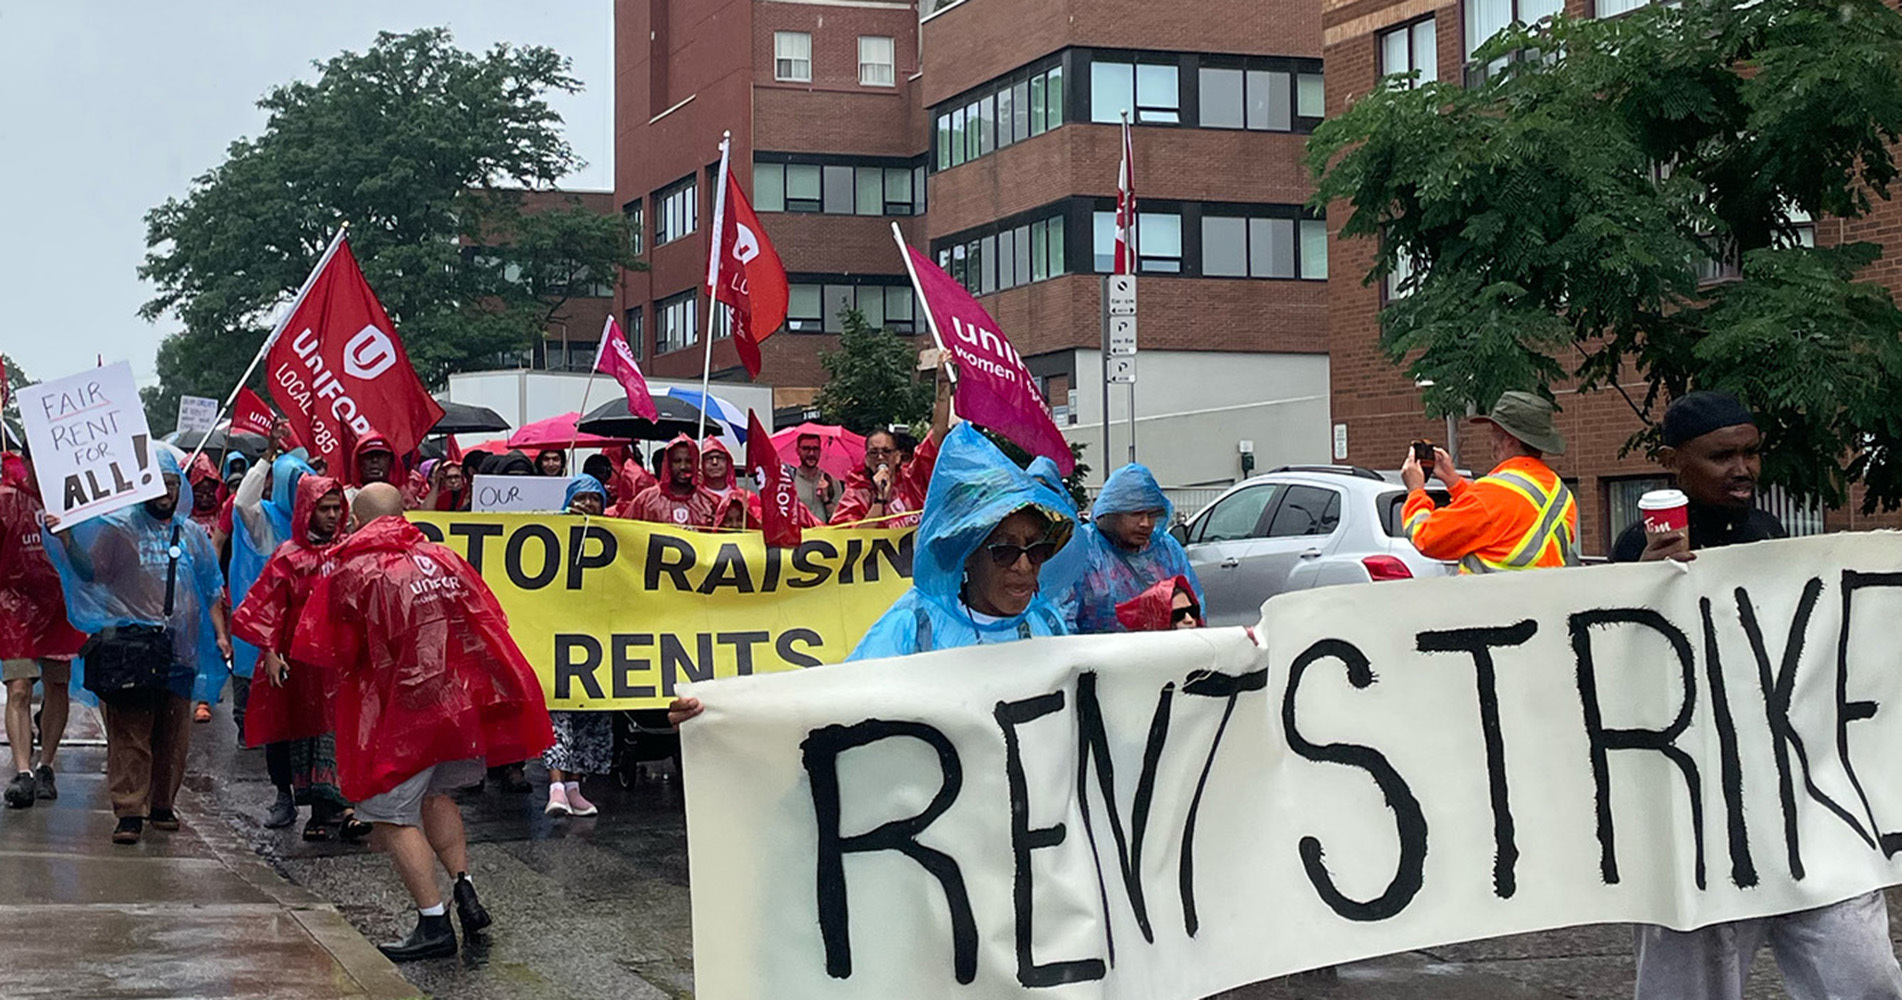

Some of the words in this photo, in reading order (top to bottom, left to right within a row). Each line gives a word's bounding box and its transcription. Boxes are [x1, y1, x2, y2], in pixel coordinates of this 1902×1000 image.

[42, 381, 105, 419] FAIR
[274, 362, 313, 416] LOCAL
[51, 410, 120, 451] RENT
[74, 441, 115, 466] FOR
[63, 433, 152, 512] ALL!
[479, 485, 523, 507] OUR
[643, 529, 916, 596] RAISIN
[553, 628, 824, 700] RENTS
[800, 668, 1269, 988] RENT
[1282, 569, 1902, 923] STRIKE
